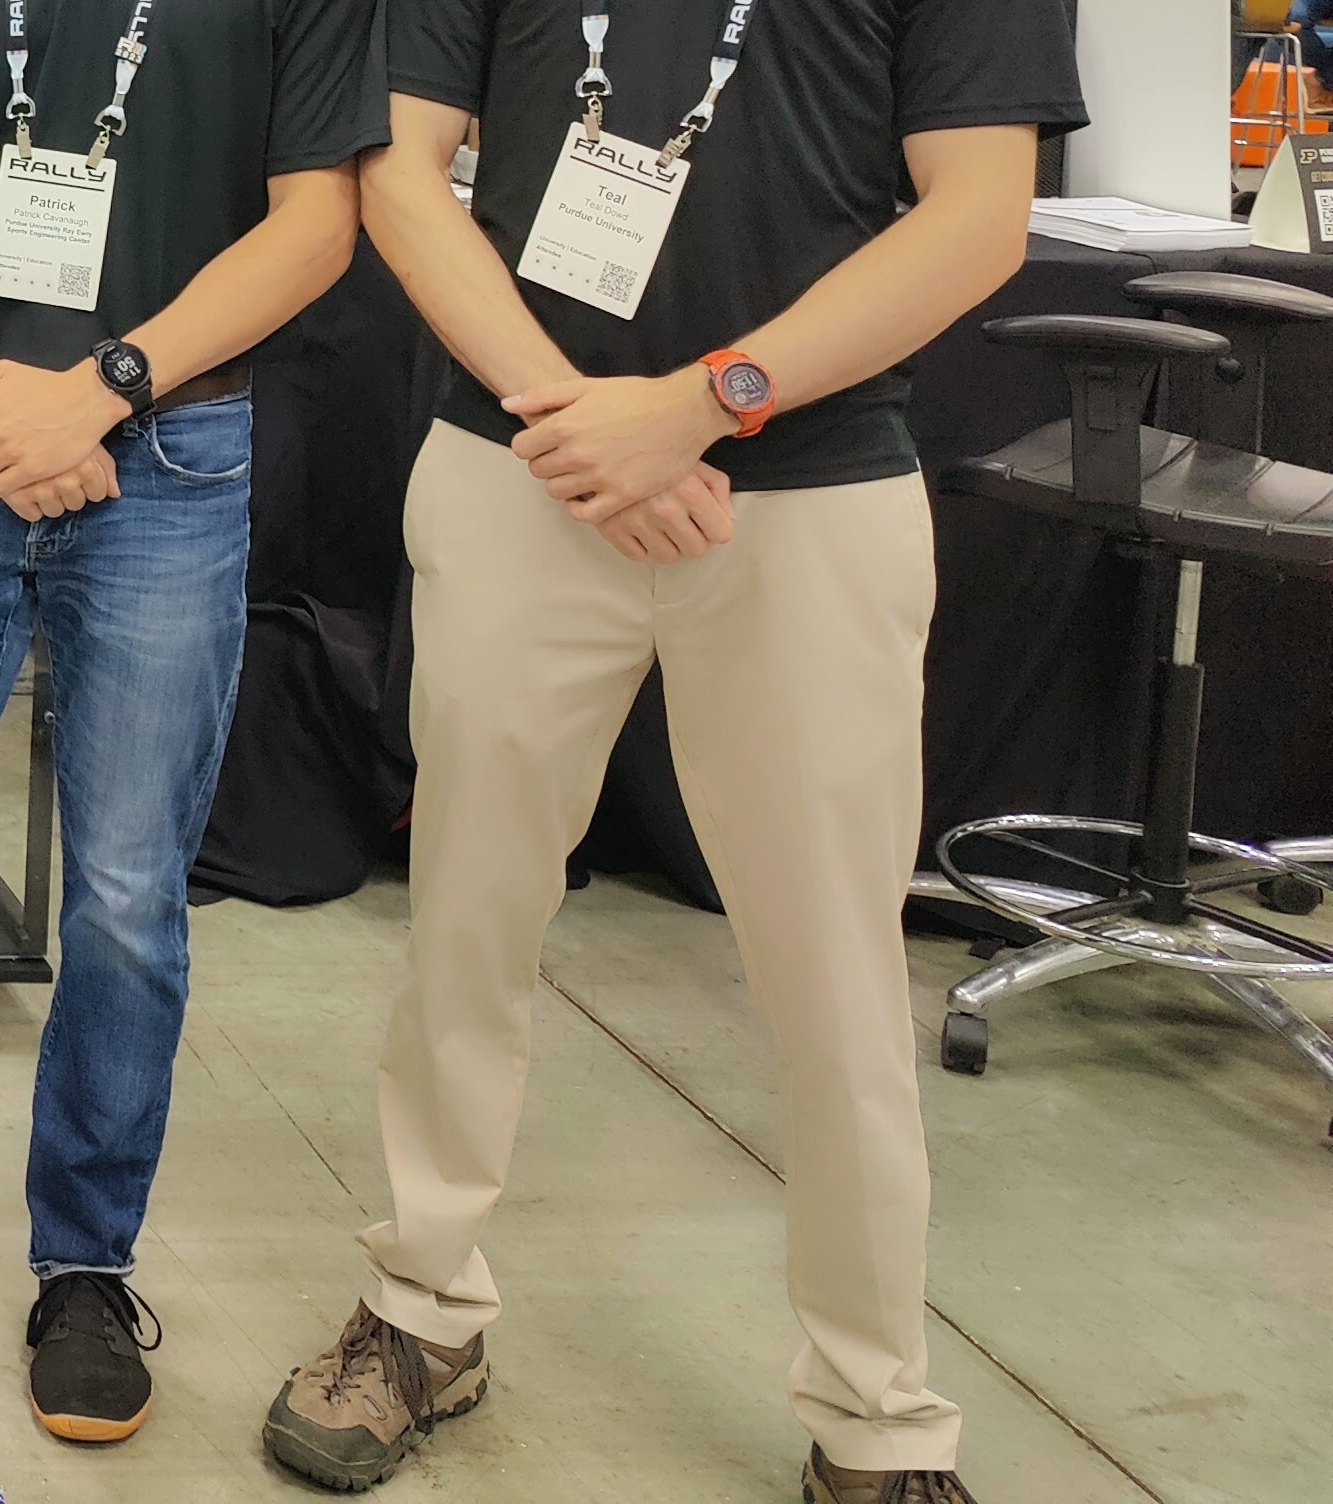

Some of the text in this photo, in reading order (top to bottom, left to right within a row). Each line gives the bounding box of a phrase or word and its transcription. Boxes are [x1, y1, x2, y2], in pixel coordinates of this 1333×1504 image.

[10, 158, 107, 183] RALLY
[574, 137, 677, 183] RALLY
[30, 195, 76, 212] Patrick
[598, 184, 627, 206] Teal
[14, 208, 89, 227] Patrick Cavanaugh
[558, 202, 645, 244] Purdue University
